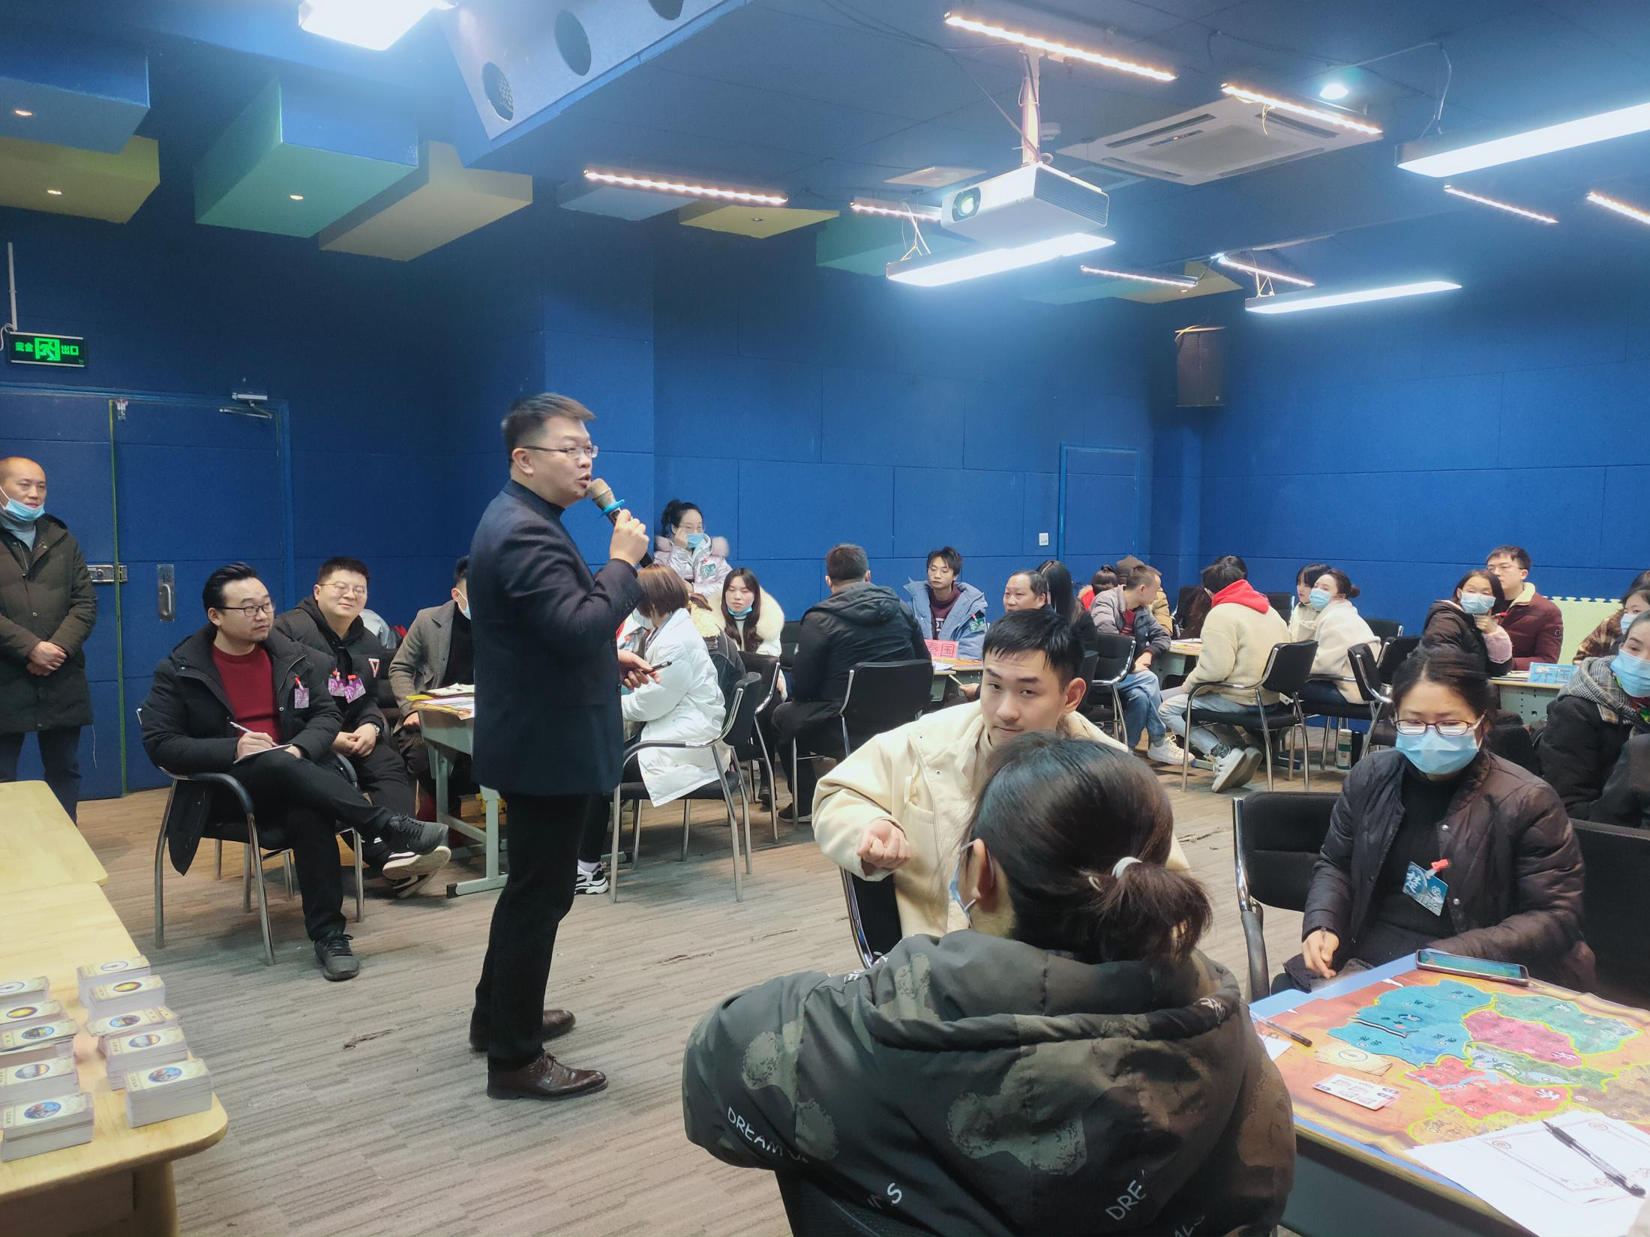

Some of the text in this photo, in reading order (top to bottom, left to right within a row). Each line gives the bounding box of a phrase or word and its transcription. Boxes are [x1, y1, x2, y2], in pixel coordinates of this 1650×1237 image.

[15, 342, 78, 355] 安全 出口
[727, 1106, 783, 1156] DREAM
[1105, 1170, 1147, 1220] DRE
